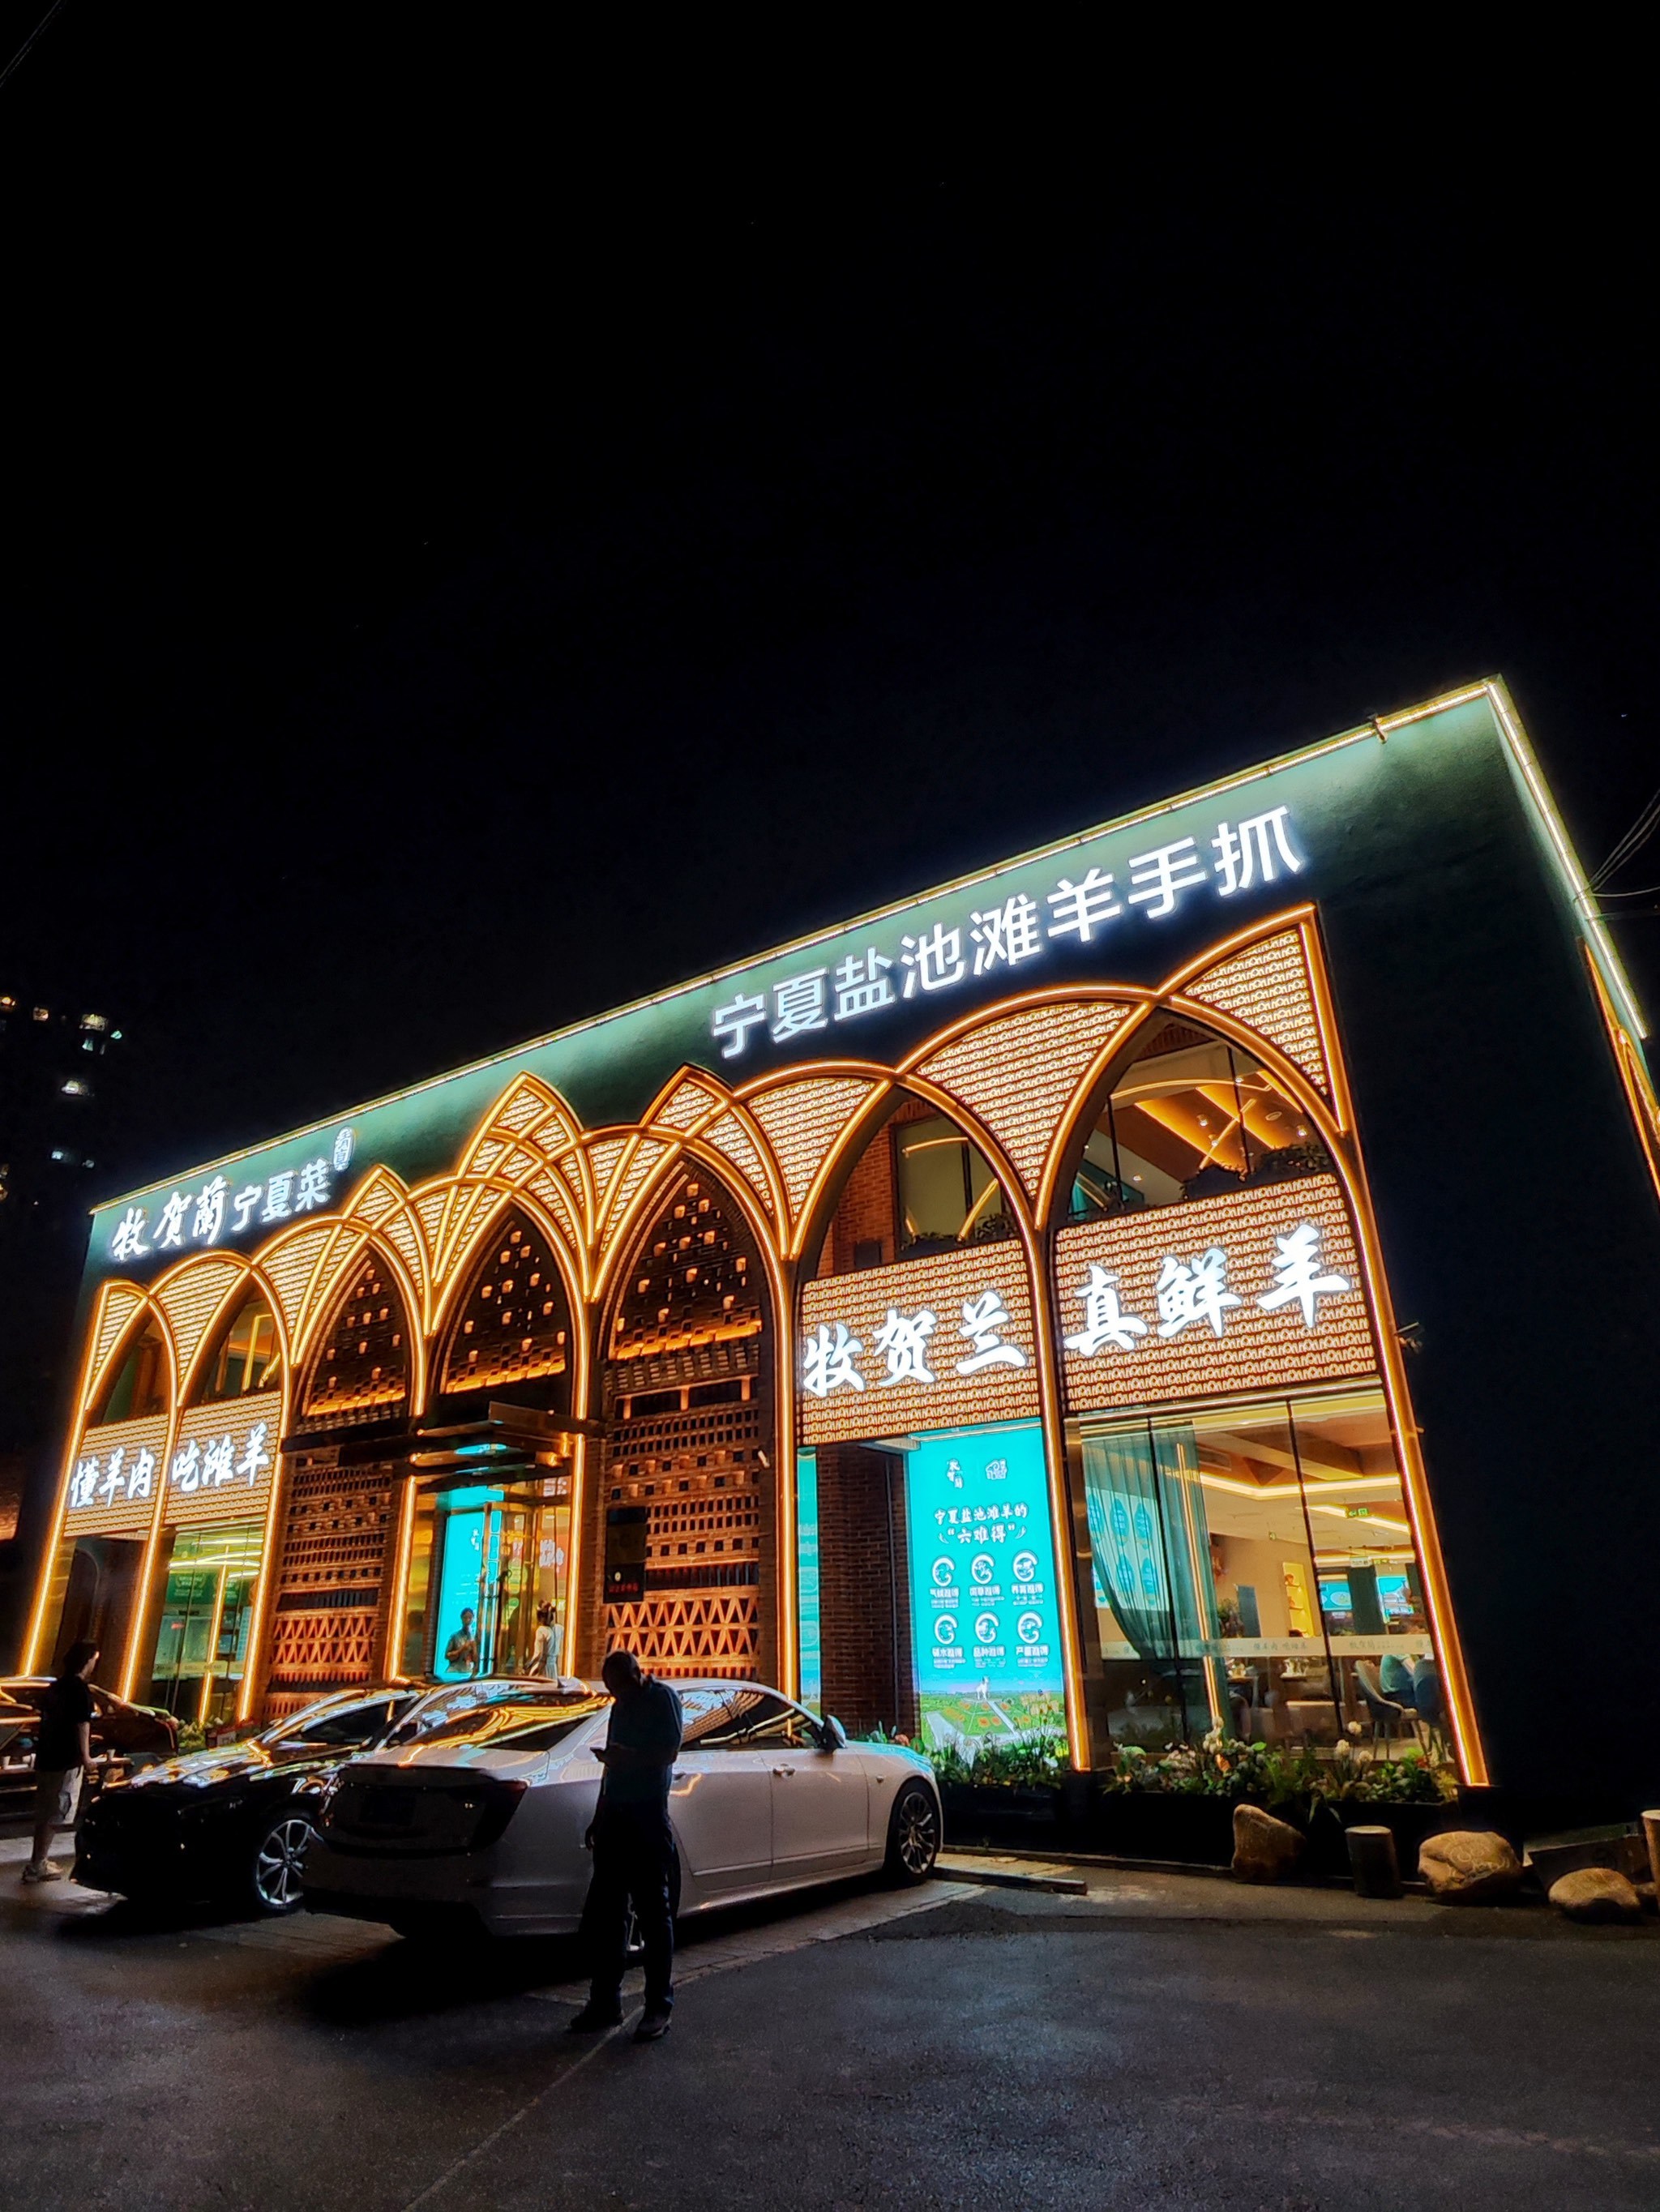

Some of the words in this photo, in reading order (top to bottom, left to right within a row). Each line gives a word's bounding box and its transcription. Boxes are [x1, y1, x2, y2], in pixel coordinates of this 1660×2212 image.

[711, 805, 1302, 1058] 宁夏盐池滩羊手抓
[802, 1290, 1026, 1397] 牧贺兰
[1063, 1224, 1350, 1357] 真鲜羊
[70, 1447, 155, 1508] 懂羊肉
[172, 1422, 269, 1491] 吃滩羊
[935, 1502, 1029, 1525] 宁夏盐池滩羊的
